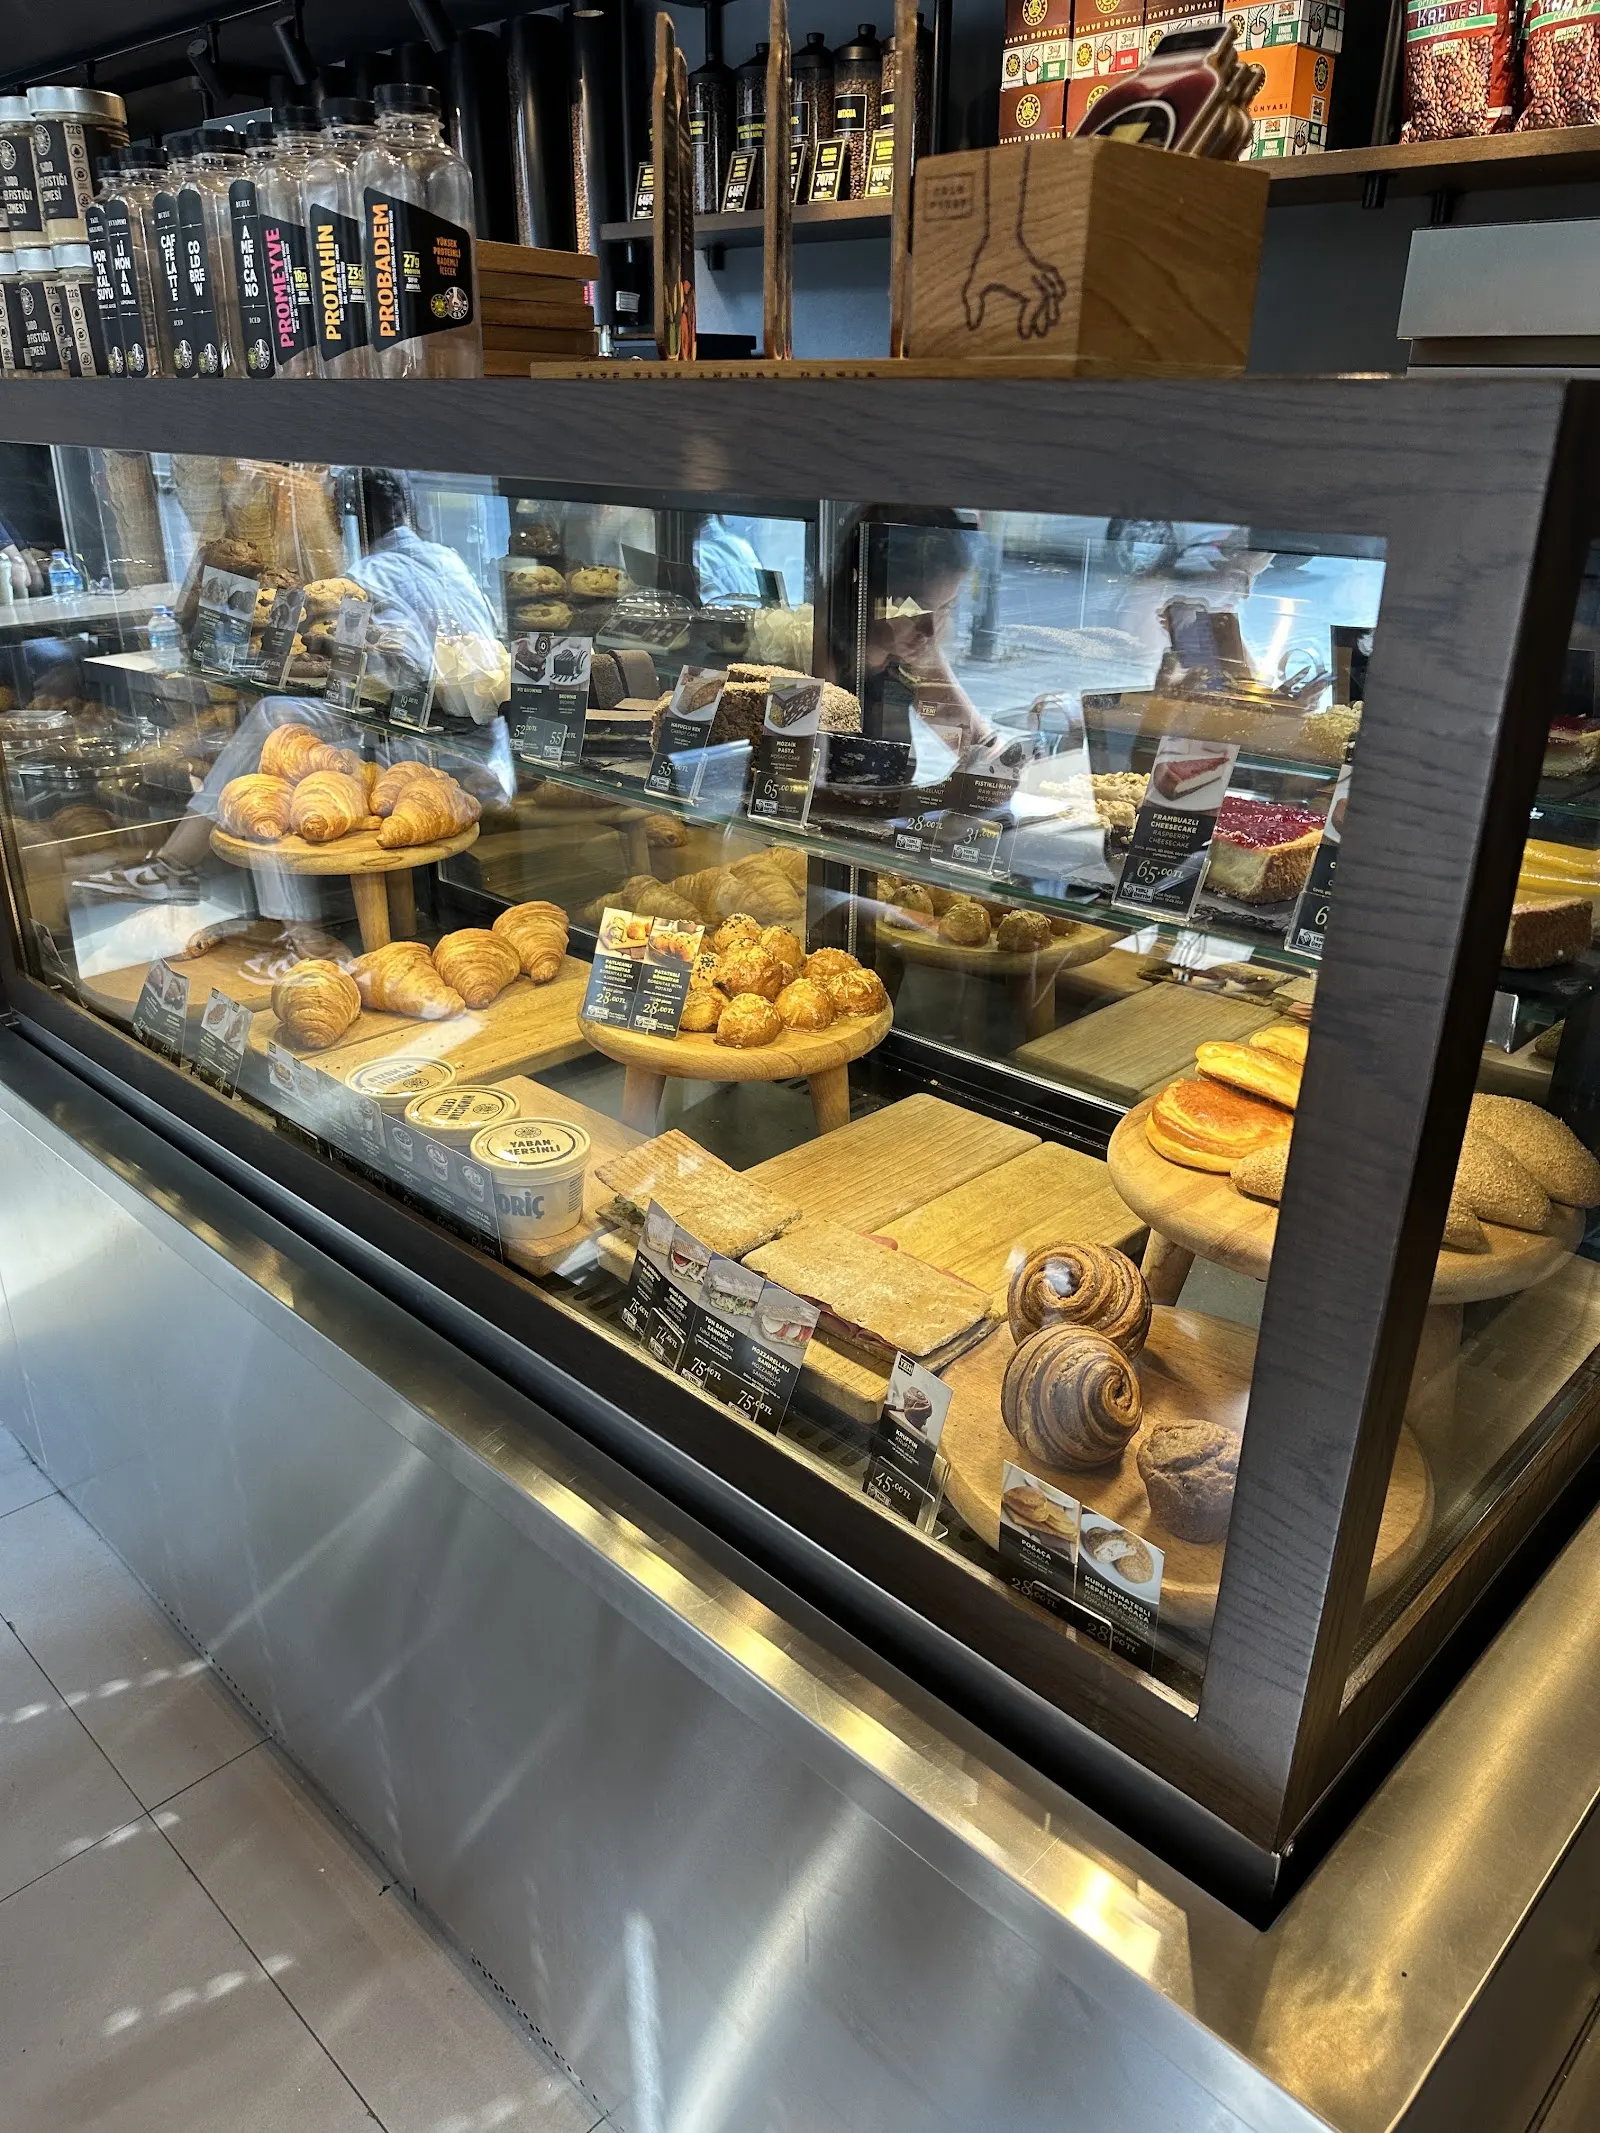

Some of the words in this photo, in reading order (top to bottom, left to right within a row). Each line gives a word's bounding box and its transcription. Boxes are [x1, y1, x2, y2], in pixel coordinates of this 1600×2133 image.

[1147, 8, 1174, 20] KAHVE
[1178, 0, 1217, 14] DÜNYASI
[1076, 23, 1101, 34] KAHVE
[1104, 15, 1141, 28] DÜNYASI
[1005, 33, 1028, 44] KAHVE
[1031, 27, 1067, 40] DÜNYASI
[1000, 134, 1022, 144] KAHVE
[1024, 131, 1060, 141] DÜNYASI
[243, 225, 250, 240] A
[188, 240, 200, 255] CO
[240, 239, 255, 254] ME
[166, 262, 178, 275] LA
[190, 255, 201, 269] LD
[403, 254, 420, 268] 27g
[96, 264, 106, 275] TA
[121, 271, 128, 283] A
[188, 268, 206, 283] BRE
[243, 268, 258, 283] CA
[372, 203, 396, 337] PROBADEM
[121, 284, 132, 296] TA
[171, 288, 179, 301] E
[194, 283, 203, 297] W
[245, 283, 259, 297] NO
[265, 227, 295, 348] PROMEYVE
[1153, 814, 1199, 826] FRAMBUAZLI
[1150, 822, 1197, 834] CHEESECAKE
[1152, 830, 1190, 841] RASPBERRY
[1148, 837, 1190, 849] CHEESECAKE
[509, 1139, 552, 1148] YABAN
[705, 1316, 716, 1327] TON
[715, 1321, 735, 1338] BALIKLI
[710, 1332, 734, 1352] SANDWICH
[752, 1345, 791, 1374] MOZZARELLALI
[758, 1356, 780, 1375] SANDVİÇ
[751, 1361, 781, 1383] MOZZARELLA
[752, 1368, 777, 1387] SANDWICH
[895, 1429, 918, 1450] KRUFFIN
[895, 1436, 916, 1454] KRUFFIN
[1021, 1538, 1052, 1561] POĞAÇA
[1084, 1574, 1107, 1591] KURU
[1106, 1585, 1151, 1618] DOMATESLİ
[1084, 1581, 1117, 1607] KEPEKLİ
[1117, 1598, 1150, 1624] POĞAÇA
[1083, 1588, 1127, 1617] WHOLEMEAL
[1128, 1612, 1149, 1631] DRIED
